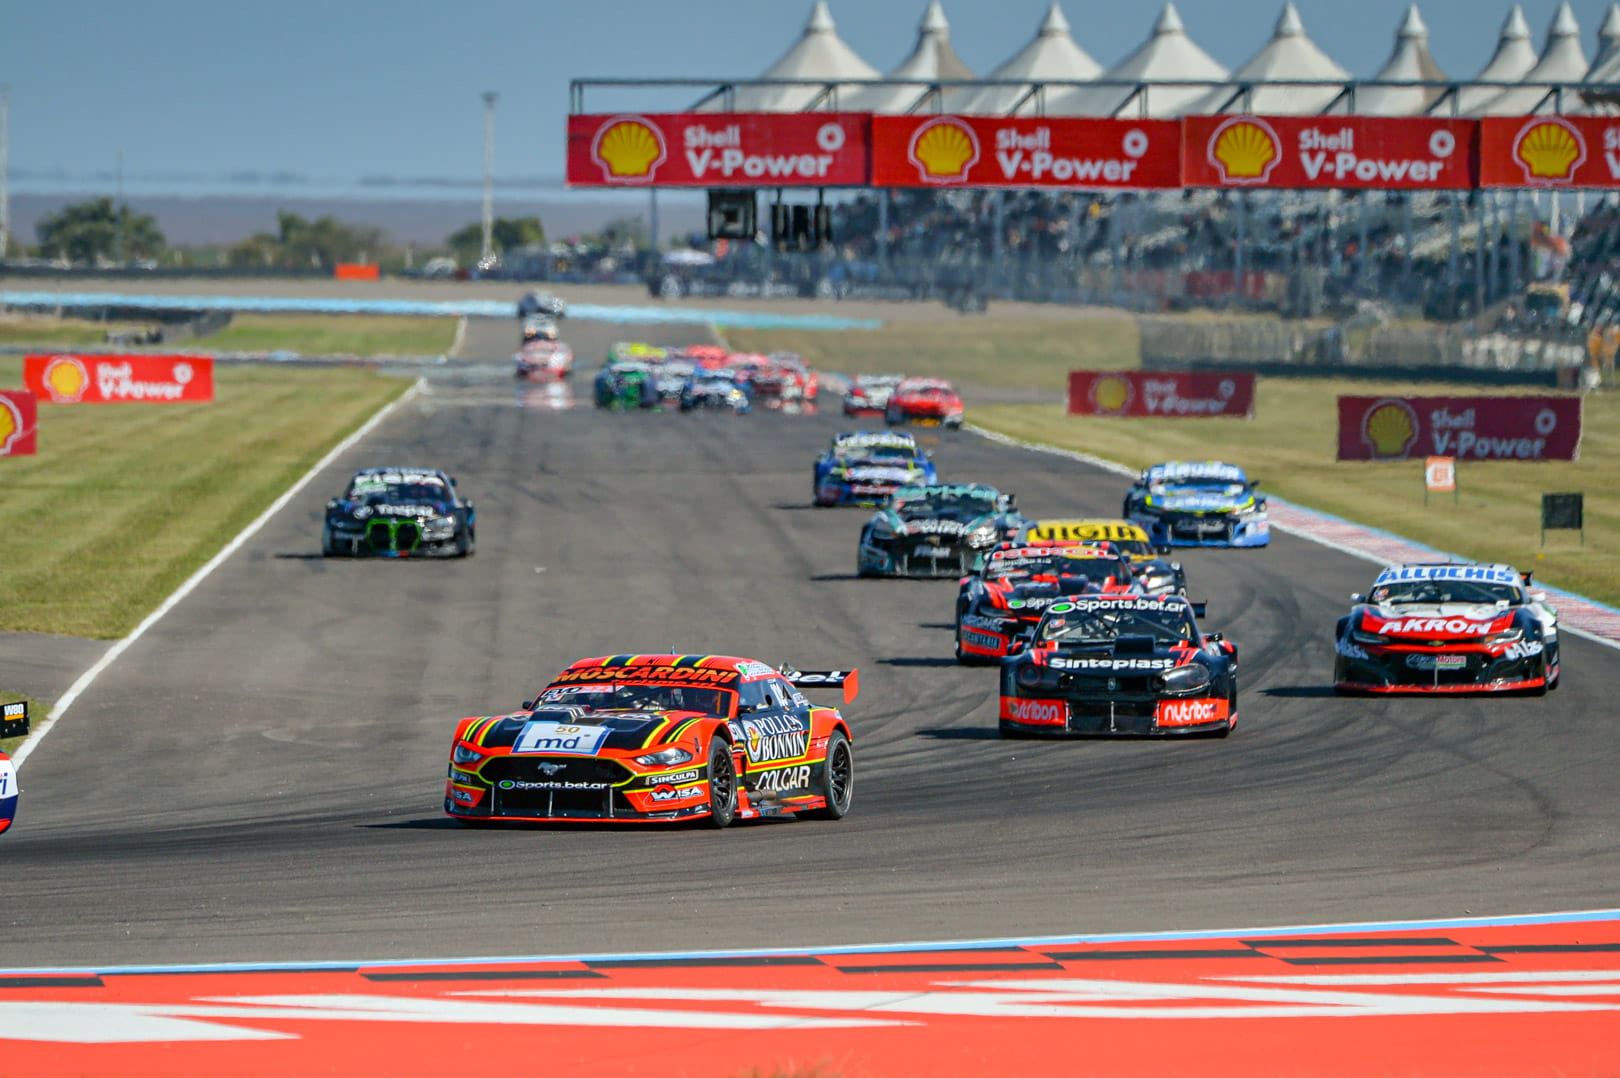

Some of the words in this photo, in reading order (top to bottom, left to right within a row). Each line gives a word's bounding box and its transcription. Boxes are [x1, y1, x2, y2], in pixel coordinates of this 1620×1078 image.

[683, 124, 741, 148] Shell
[996, 127, 1050, 152] Shell
[1299, 127, 1353, 151] Shell
[686, 149, 833, 179] V-Power
[1000, 151, 1137, 181] V-Power
[1301, 151, 1443, 181] V-Power
[1431, 407, 1476, 429] Shell
[1432, 430, 1546, 458] V-Power
[1376, 567, 1514, 583] ALLOCHIS
[1076, 597, 1187, 613] Sports.bet.ar
[1379, 618, 1493, 635] AKRON
[1050, 658, 1175, 670] Sinteplast
[552, 666, 739, 684] MOSCARDINI
[555, 725, 580, 734] 50
[534, 736, 580, 750] md
[762, 733, 806, 762] BONNIN
[515, 780, 607, 790] Sports.bet.ar
[651, 771, 697, 785] SINCULPA
[756, 765, 811, 791] COLCAR
[650, 787, 704, 802] WISA
